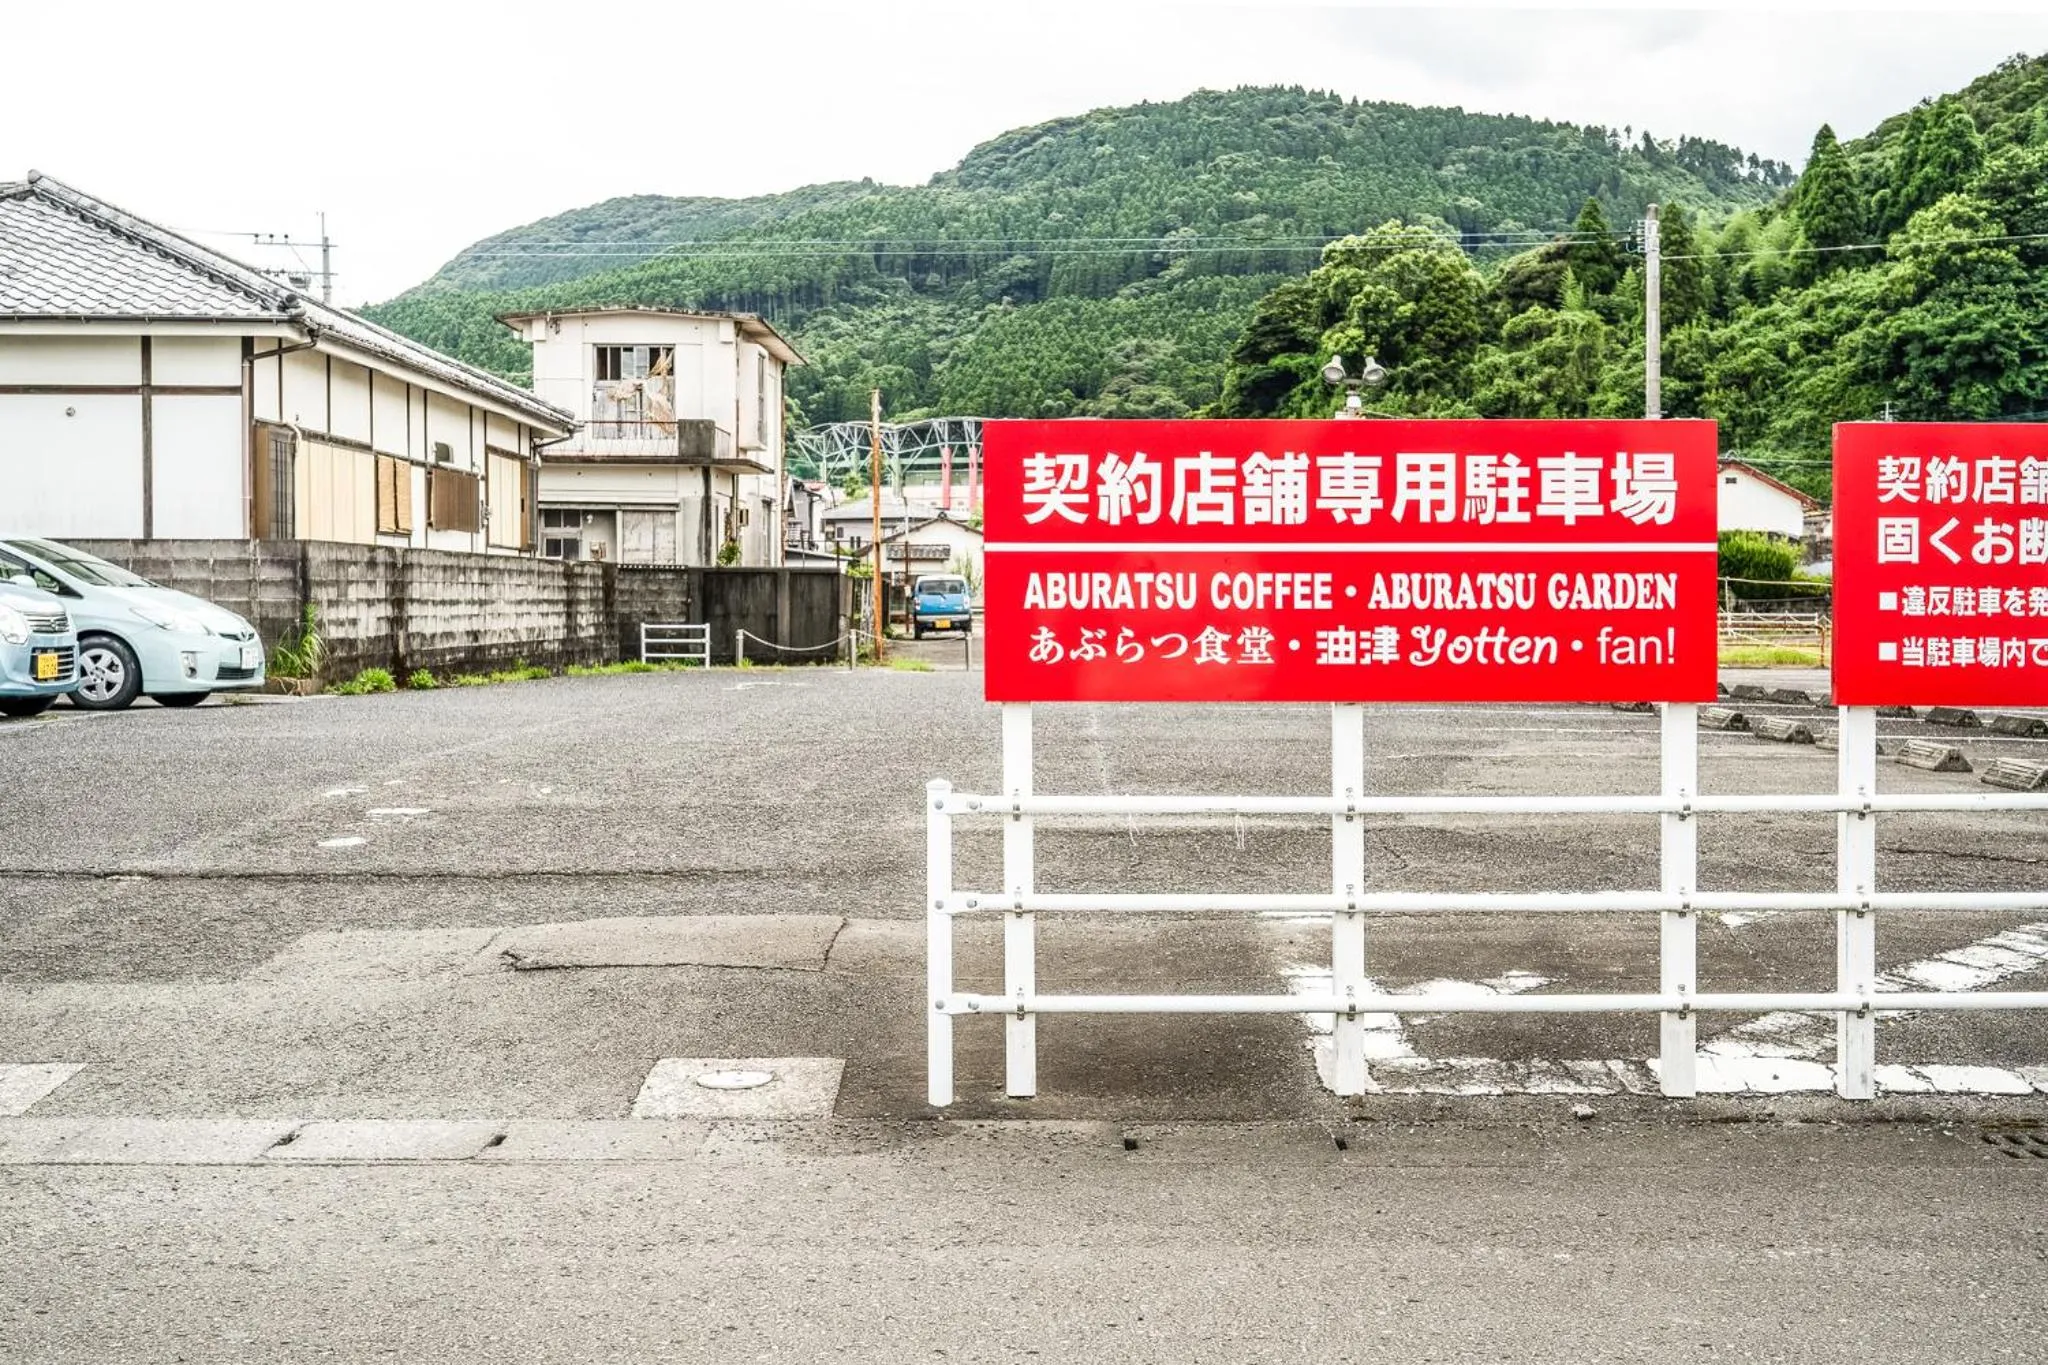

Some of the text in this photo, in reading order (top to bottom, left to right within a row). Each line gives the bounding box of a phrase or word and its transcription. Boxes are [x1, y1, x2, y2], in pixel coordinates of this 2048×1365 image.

[1022, 451, 1679, 526] 契約店舗専用駐車場
[1023, 571, 1678, 611] ABURATSU COFFEE ABURATSU GARDEN
[1028, 624, 1275, 666] あぶらつ食堂
[1597, 625, 1675, 665] fan!
